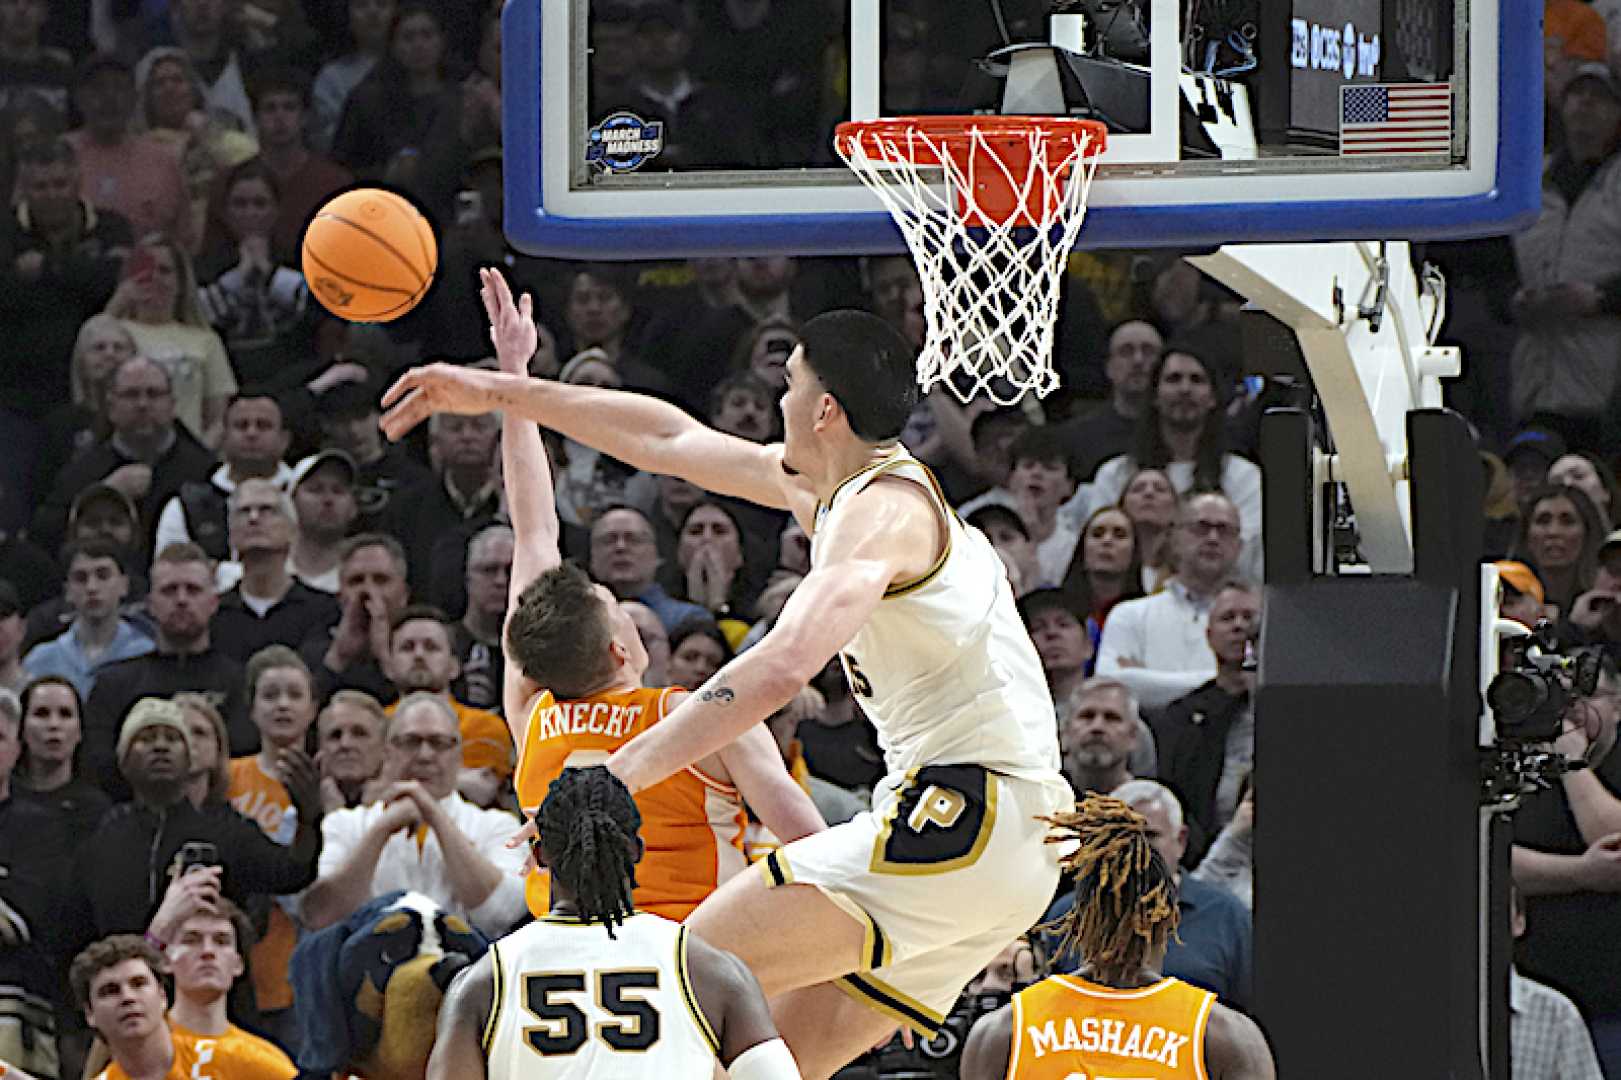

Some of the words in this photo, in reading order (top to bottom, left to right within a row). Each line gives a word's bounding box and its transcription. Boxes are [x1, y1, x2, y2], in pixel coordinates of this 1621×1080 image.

[602, 128, 640, 142] MARCH
[607, 140, 661, 154] MADNESS
[540, 702, 643, 741] KNECHT
[521, 968, 660, 1057] 55
[1027, 1017, 1189, 1068] MASHACK
